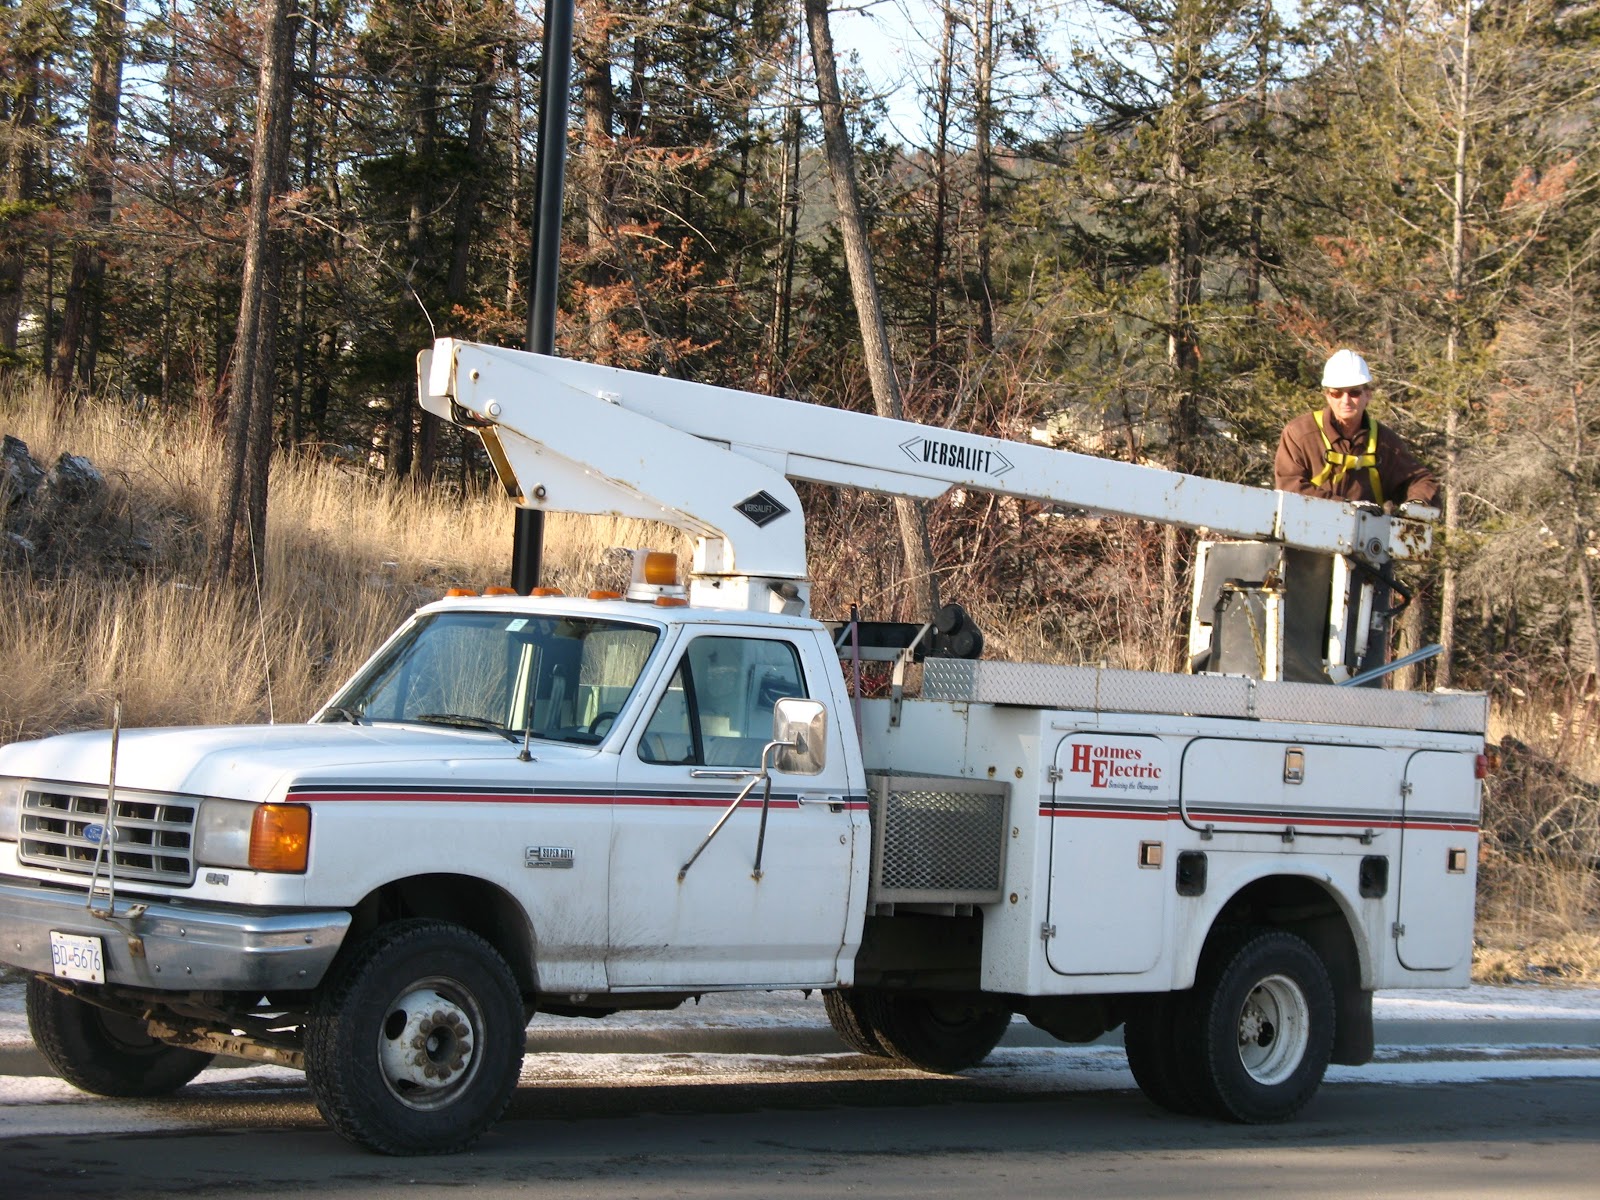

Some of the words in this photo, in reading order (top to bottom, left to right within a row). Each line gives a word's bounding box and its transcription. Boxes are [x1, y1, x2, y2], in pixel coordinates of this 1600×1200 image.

[923, 439, 992, 474] VERSALIFT
[744, 503, 773, 513] VERSALIFT
[1070, 744, 1142, 773] Holmes
[1090, 760, 1162, 788] Electric
[542, 848, 560, 858] SUPER
[560, 848, 574, 859] DUTY
